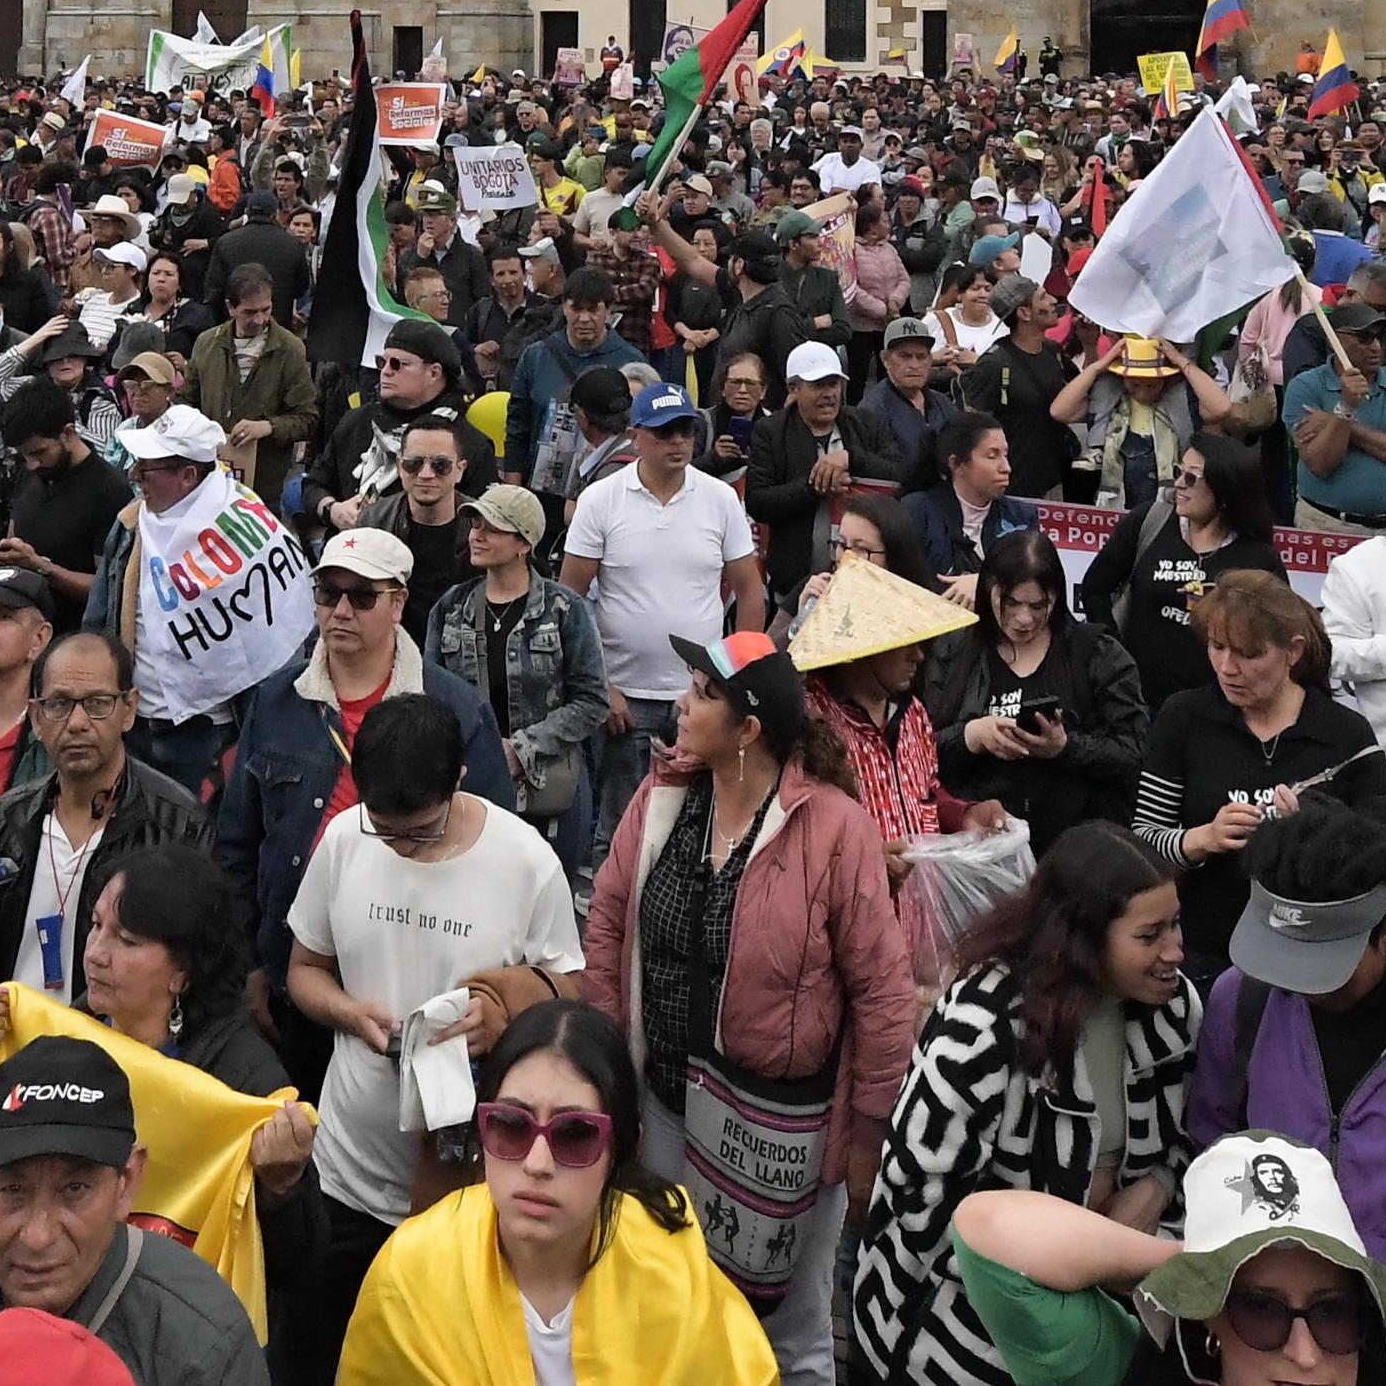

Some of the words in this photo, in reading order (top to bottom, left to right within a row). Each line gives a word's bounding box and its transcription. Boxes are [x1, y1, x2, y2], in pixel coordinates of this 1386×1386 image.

[390, 106, 434, 119] Reformas
[461, 157, 525, 176] UNITARIOS
[1158, 559, 1173, 570] YO
[1175, 560, 1196, 571] SOY
[1227, 790, 1249, 804] YO
[368, 902, 410, 926] trust
[418, 913, 437, 931] no
[443, 917, 472, 937] one
[1273, 903, 1303, 921] NIKE
[22, 1083, 105, 1103] FONCEP
[723, 1116, 808, 1165] RECUERDOS
[719, 1141, 749, 1168] DEL
[755, 1157, 805, 1190] LLANO
